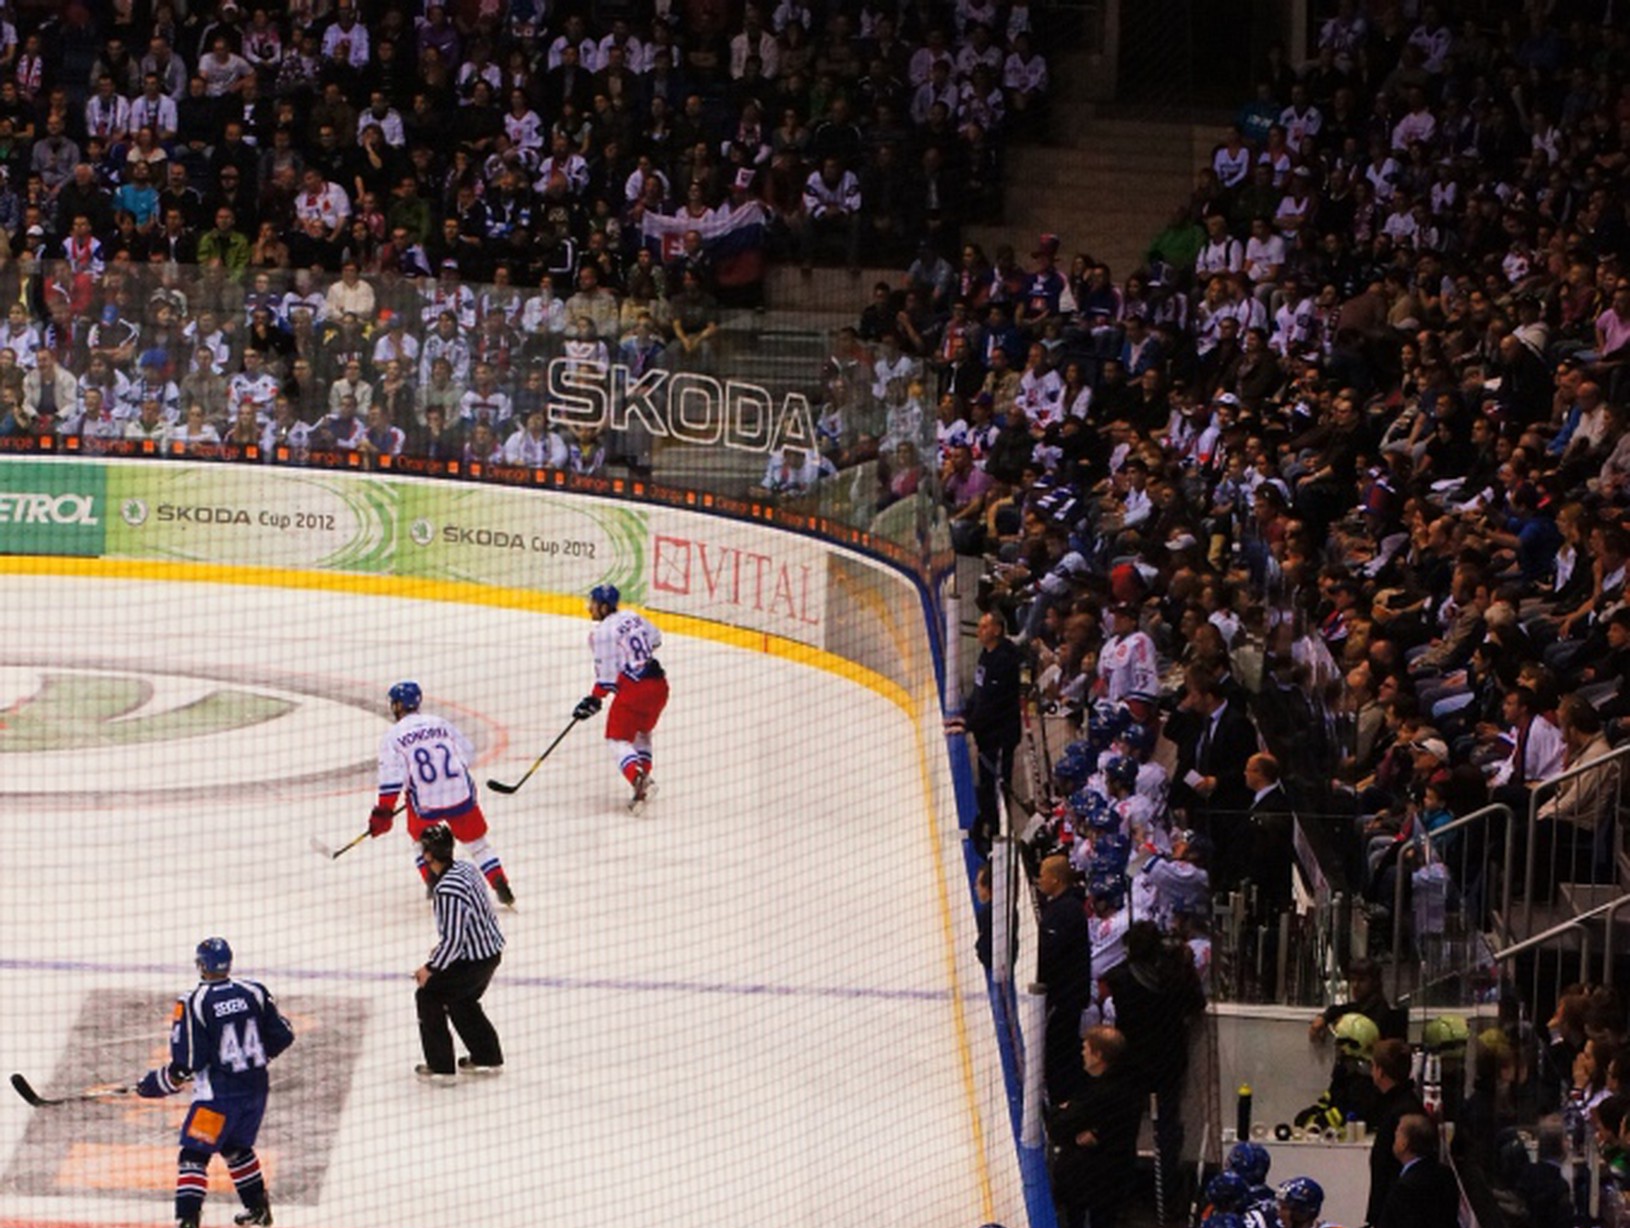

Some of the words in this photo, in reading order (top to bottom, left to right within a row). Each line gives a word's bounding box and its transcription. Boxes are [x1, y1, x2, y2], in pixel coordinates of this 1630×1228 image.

[258, 510, 291, 530] Cup
[295, 512, 335, 531] 2012
[532, 536, 559, 558] Cup
[563, 539, 595, 560] 2012
[697, 543, 819, 626] VITAL
[414, 743, 459, 784] 82
[219, 1016, 267, 1073] 44
